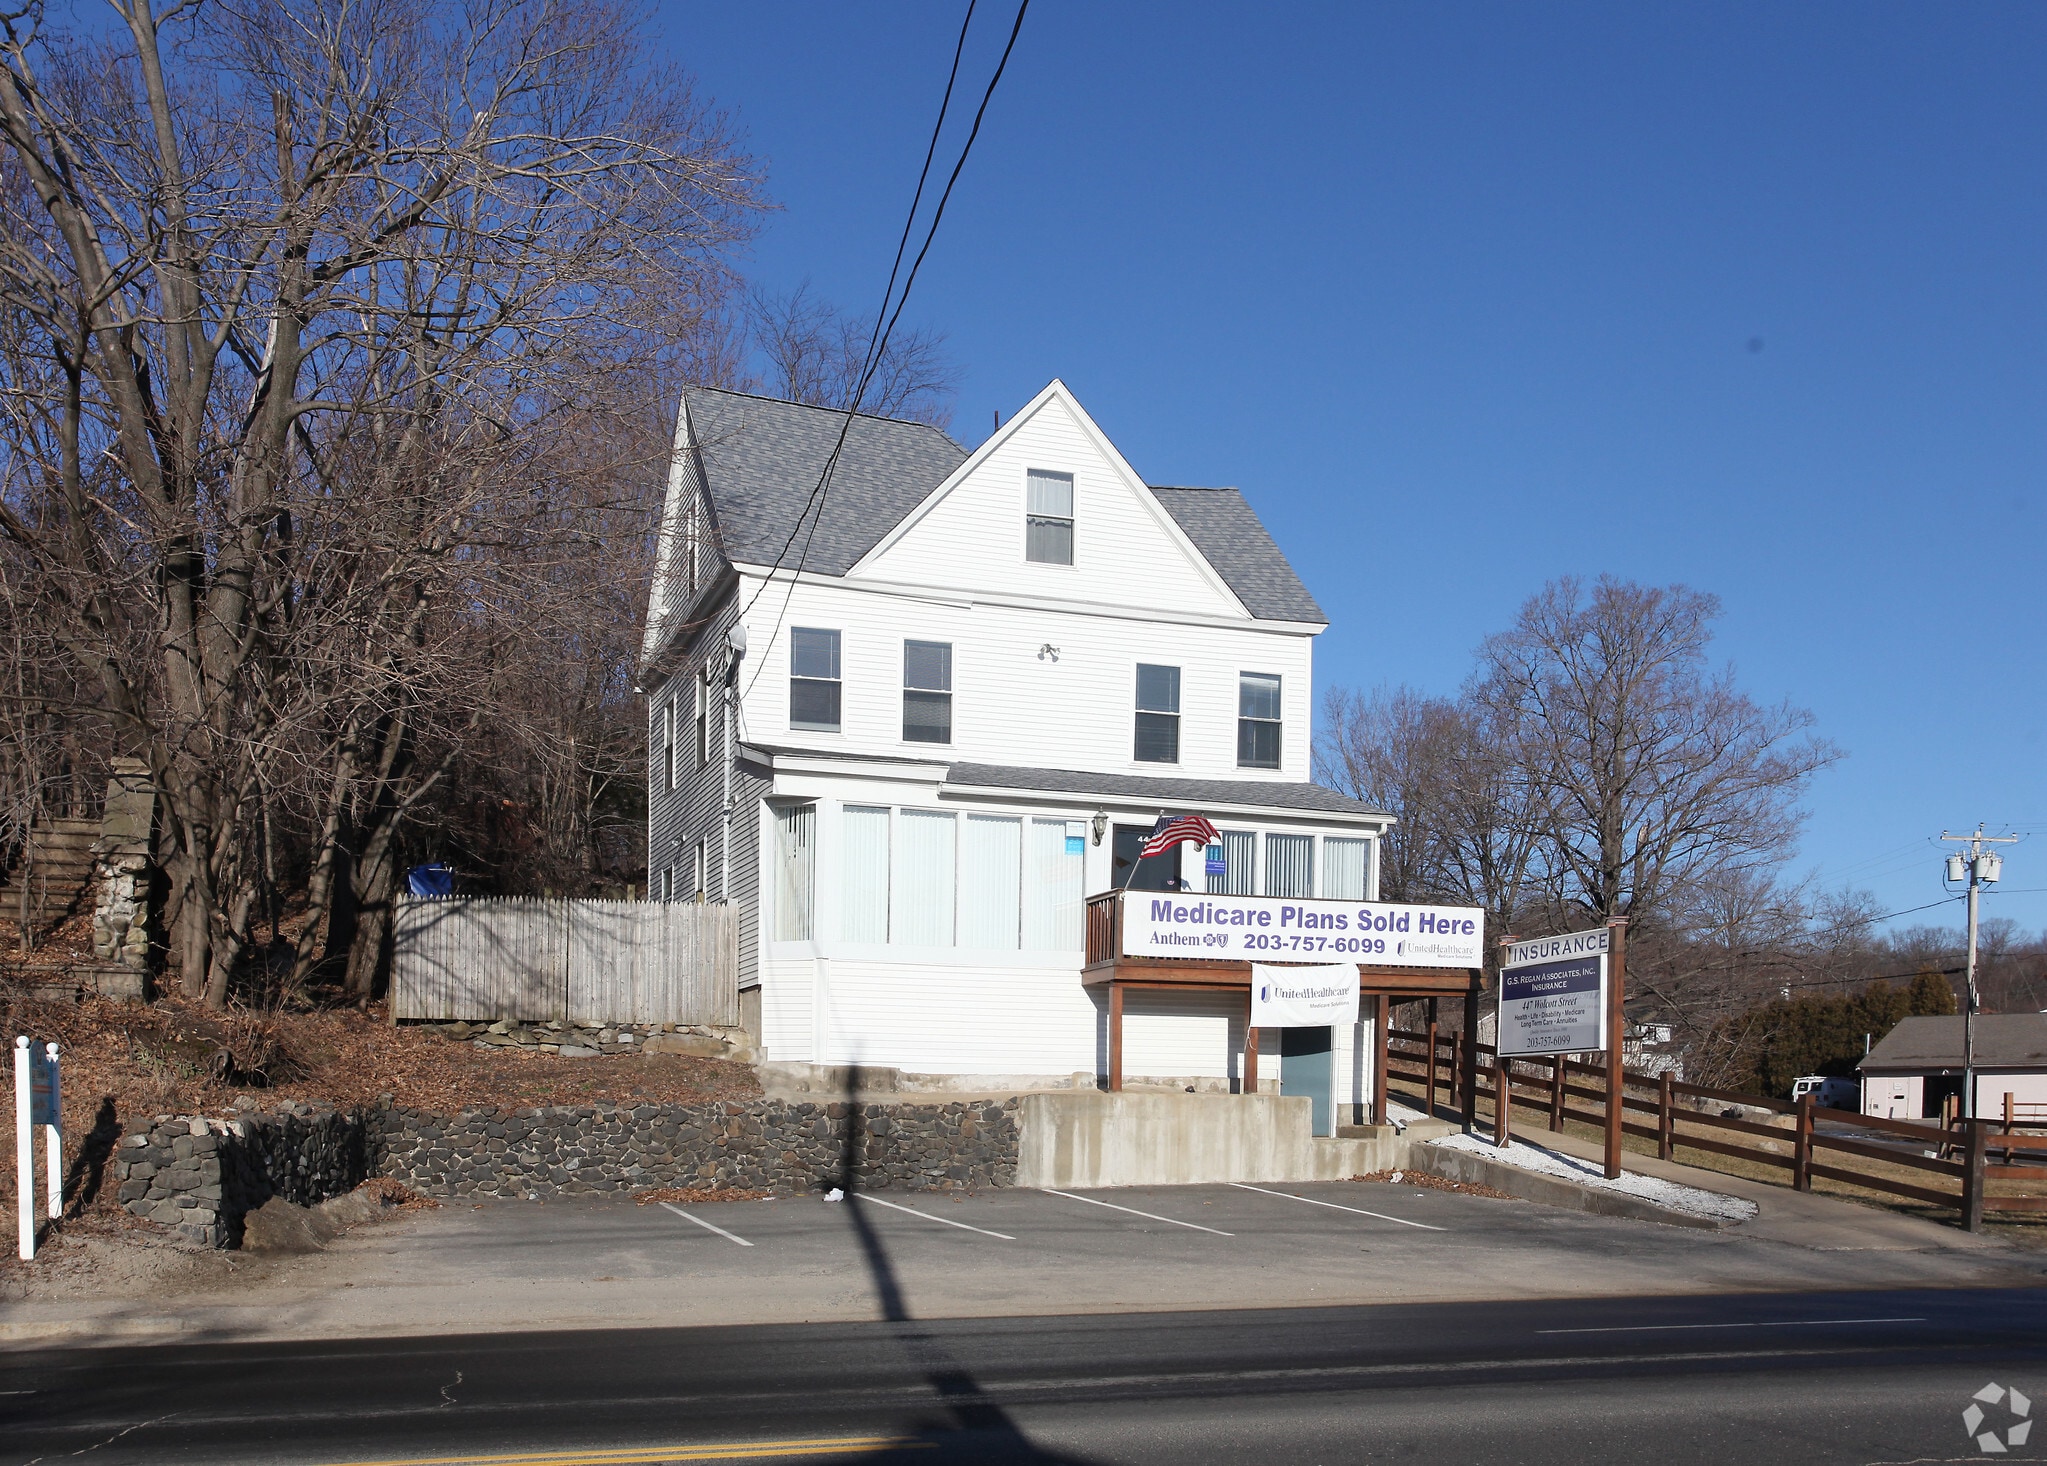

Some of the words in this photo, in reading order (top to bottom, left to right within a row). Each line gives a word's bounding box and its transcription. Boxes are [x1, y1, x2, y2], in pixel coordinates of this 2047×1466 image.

[1151, 900, 1271, 926] Medicare
[1281, 906, 1348, 930] Plans
[1357, 909, 1410, 932] Sold
[1419, 912, 1475, 935] Here
[1149, 931, 1200, 946] Anthem
[1243, 933, 1385, 953] 203-757-6099
[1408, 942, 1474, 955] UnitedHealthcare
[1513, 933, 1608, 962] INSURANCE
[1506, 976, 1519, 986] G.S.
[1274, 987, 1350, 999] UnitedHealthcare
[1522, 1000, 1534, 1010] 447
[1534, 998, 1558, 1009] Wolcott
[1558, 997, 1578, 1008] Street
[1514, 1013, 1528, 1021] Health
[1541, 1010, 1561, 1019] Disability
[1564, 1008, 1585, 1016] Medicare
[1520, 1020, 1532, 1028] Long
[1526, 1035, 1571, 1048] 203-757-6099
